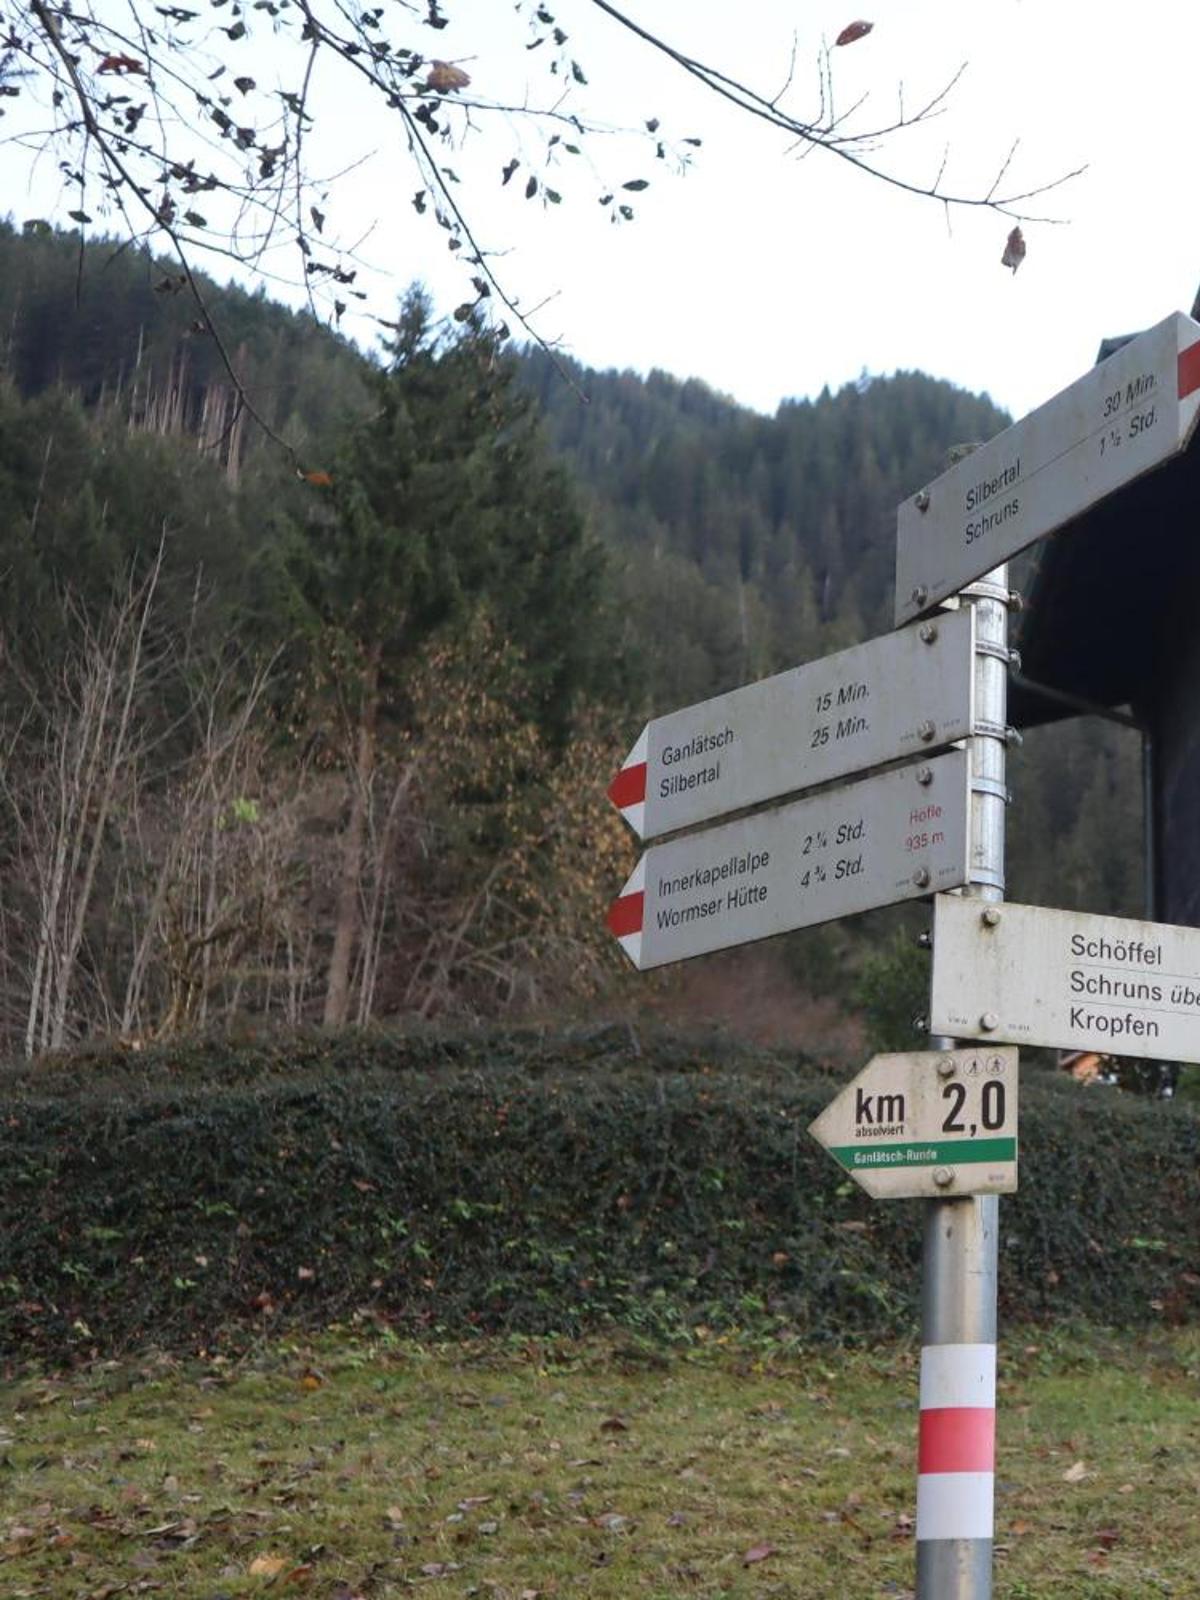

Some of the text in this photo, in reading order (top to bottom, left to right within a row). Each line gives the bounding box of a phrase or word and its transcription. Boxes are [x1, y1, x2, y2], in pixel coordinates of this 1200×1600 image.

[966, 373, 1158, 511] Silbertal 30 Min.
[966, 499, 1019, 545] Schruns
[1129, 405, 1158, 438] Std.
[660, 716, 869, 798] Silbertal 25 Min.
[662, 683, 870, 766] Ganlätsch 15 Min.
[659, 851, 770, 897] Innerkapellalpe
[836, 818, 866, 845] Std.
[905, 831, 944, 852] 935 m
[657, 899, 722, 929] Wormser
[727, 885, 768, 910] Hütte
[835, 853, 865, 879] Std.
[1070, 934, 1162, 965] Schöffel
[1070, 970, 1163, 1001] Schruns
[1070, 1007, 1159, 1038] Kropfen
[855, 1080, 1006, 1137] km 2,0
[855, 1125, 905, 1137] absolviert
